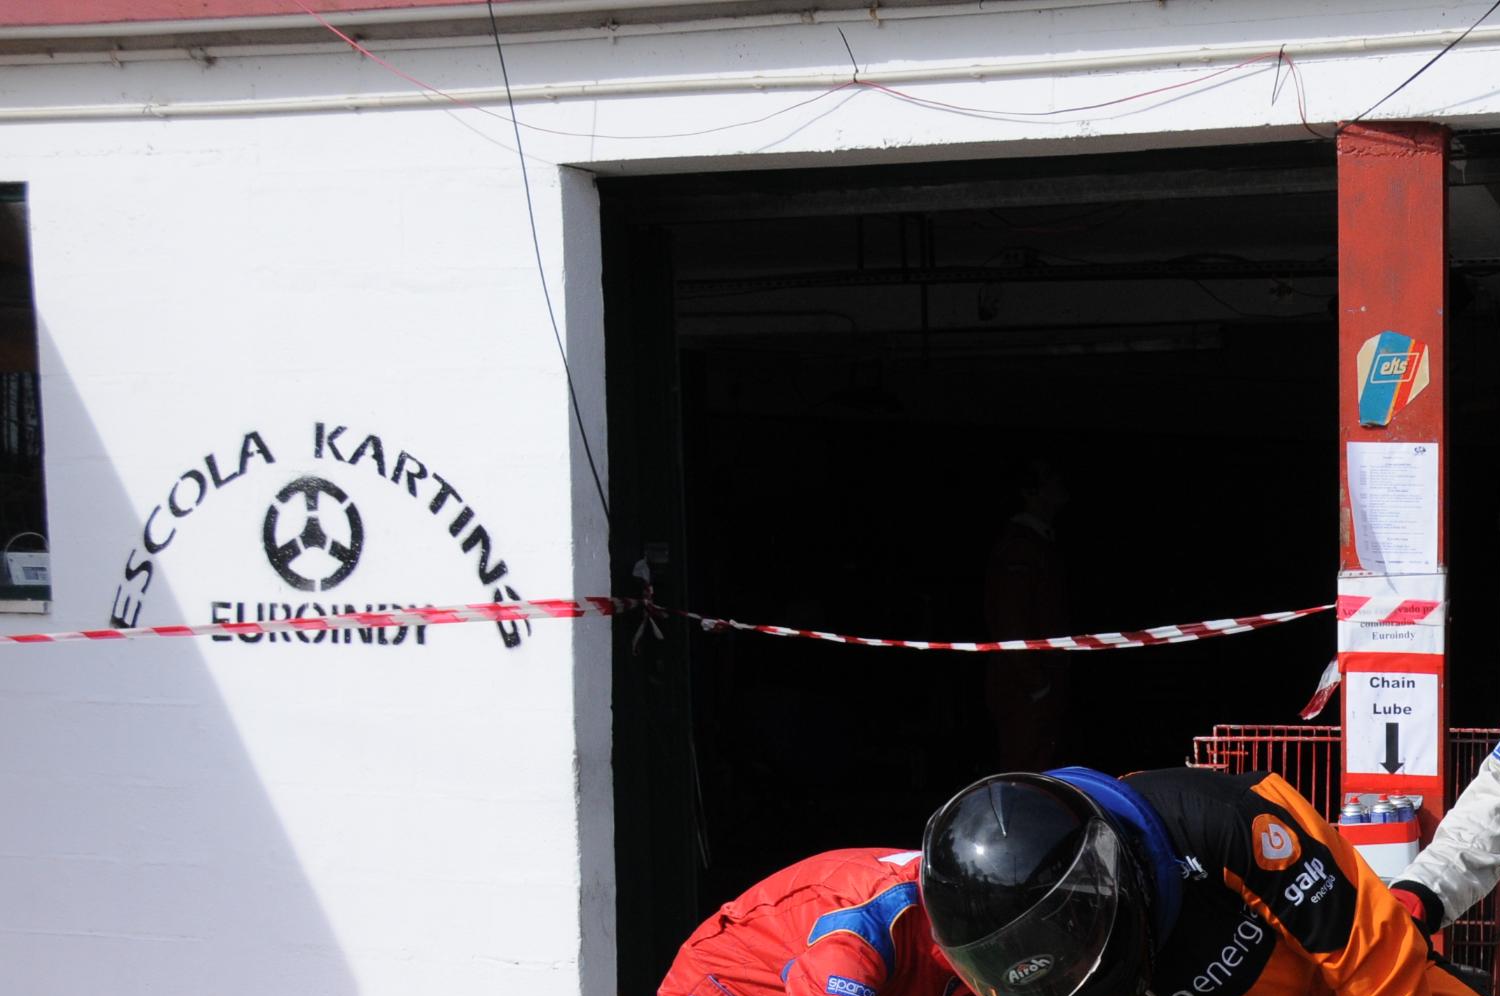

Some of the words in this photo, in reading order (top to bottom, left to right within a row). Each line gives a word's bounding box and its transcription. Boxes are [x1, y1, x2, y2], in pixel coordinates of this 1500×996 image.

[110, 430, 276, 629] ESCOLA
[314, 421, 532, 649] KARTING
[211, 602, 435, 645] EUROINDY
[1372, 631, 1416, 641] Euroindy
[1369, 676, 1416, 689] Chain
[1373, 703, 1412, 715] Lube
[1285, 857, 1327, 907] galp
[1009, 958, 1051, 984] Airoh
